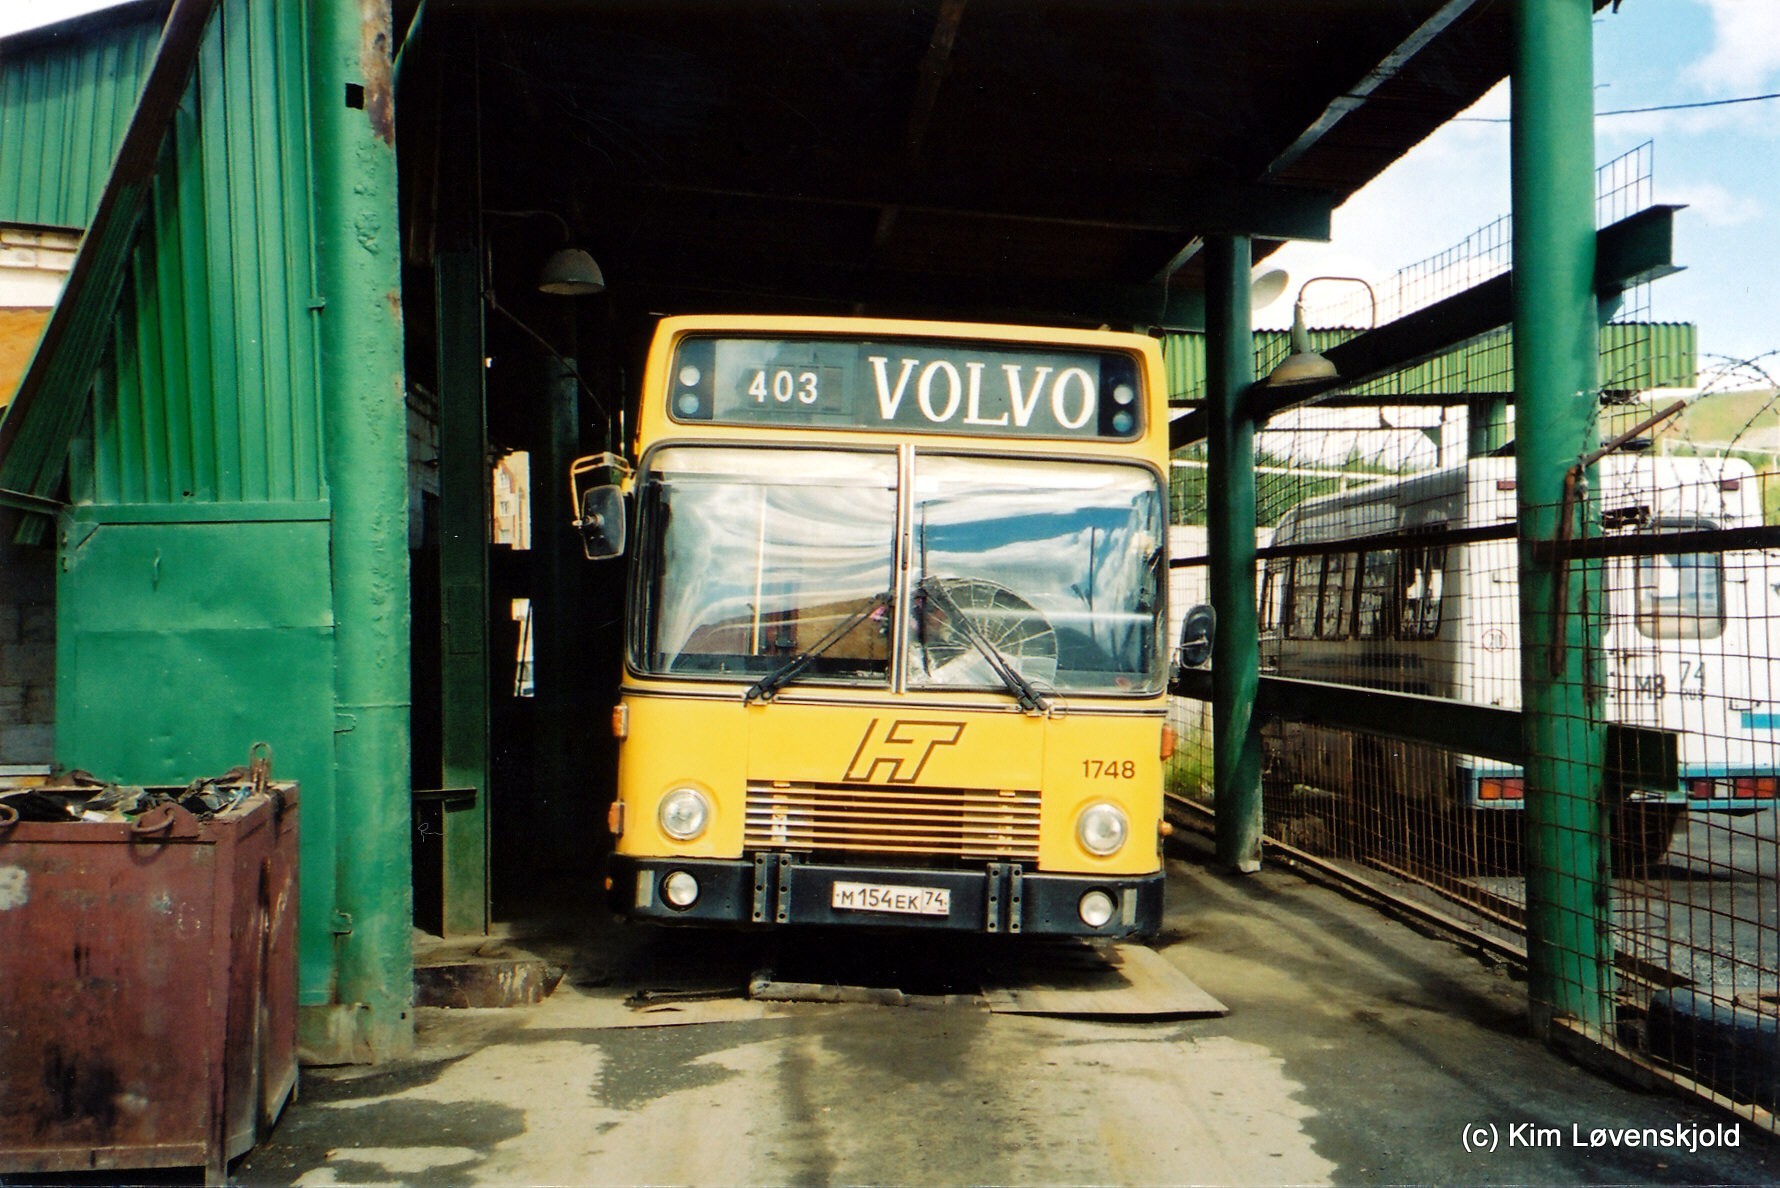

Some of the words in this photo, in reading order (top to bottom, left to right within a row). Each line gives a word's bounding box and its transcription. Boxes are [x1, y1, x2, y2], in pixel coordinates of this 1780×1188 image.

[748, 370, 818, 404] 403
[868, 356, 1096, 430] VOLVO
[1082, 759, 1136, 779] 1748
